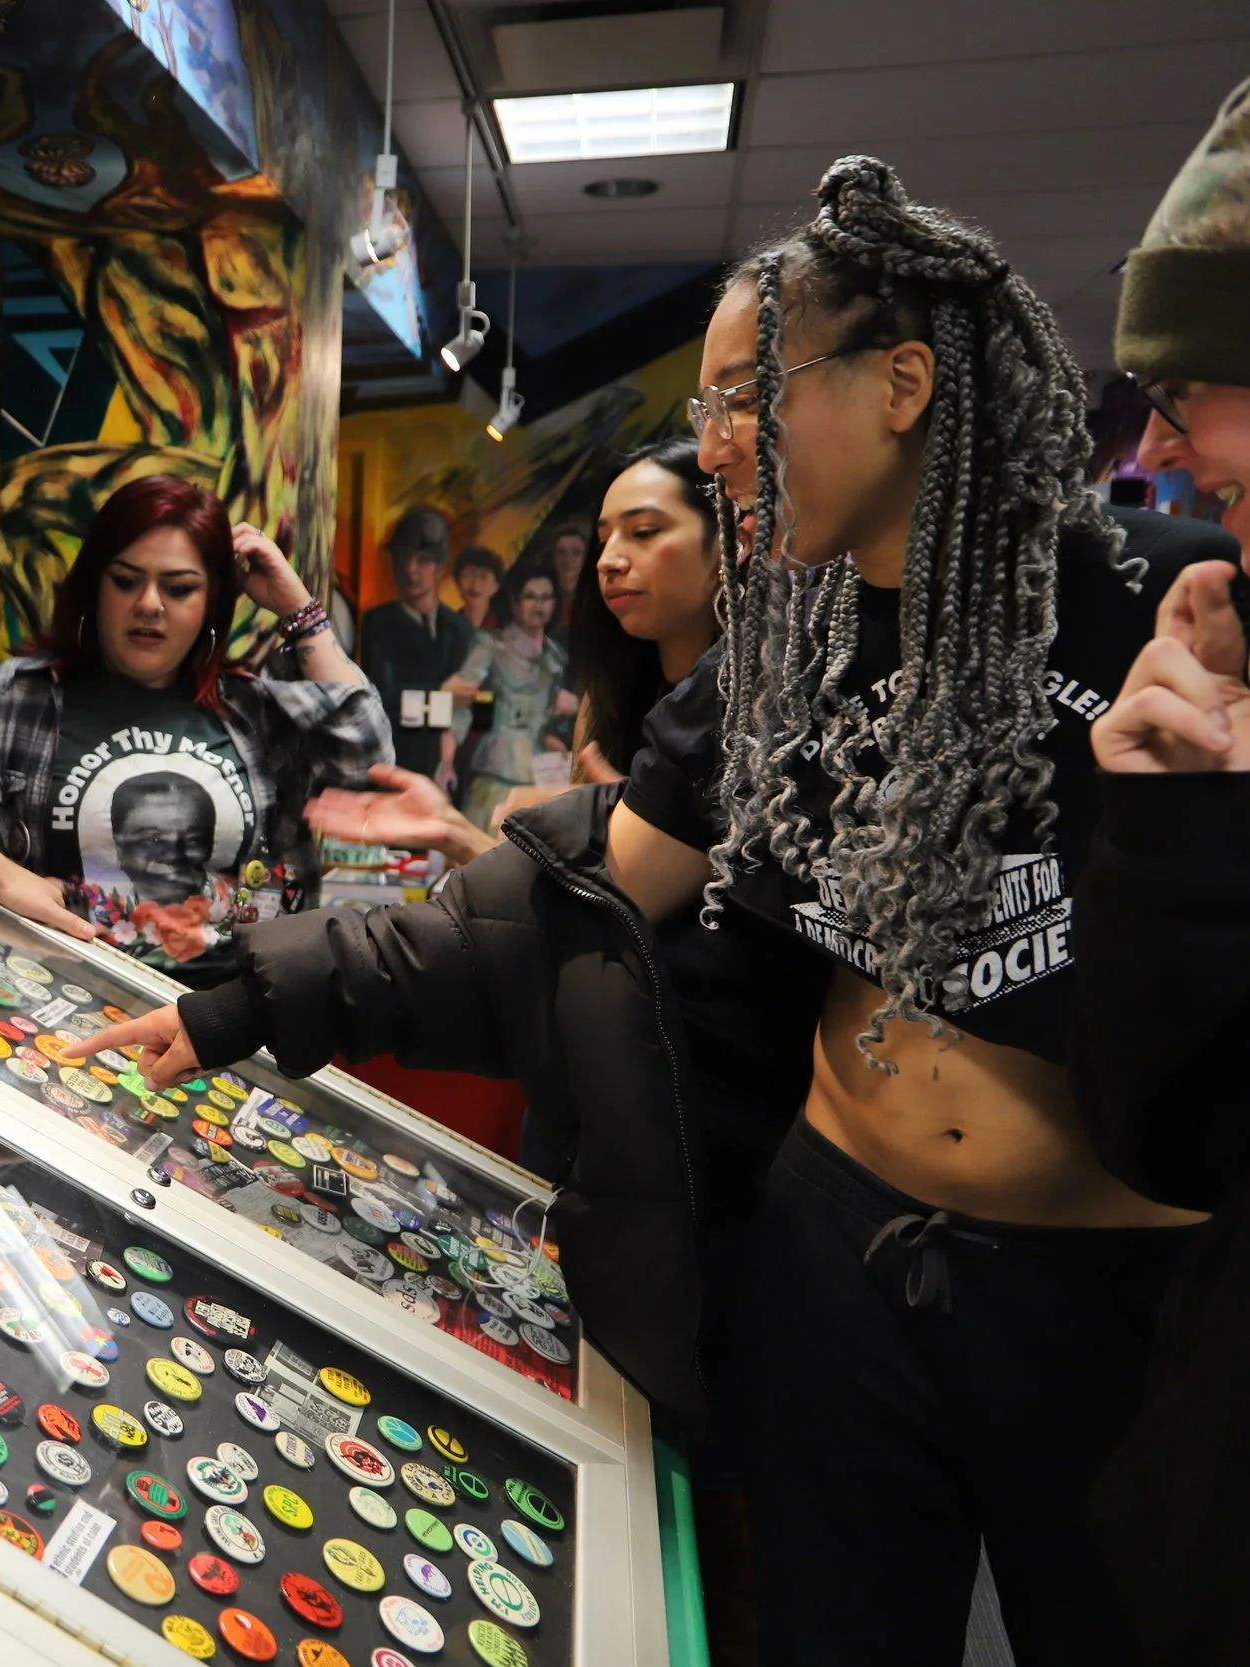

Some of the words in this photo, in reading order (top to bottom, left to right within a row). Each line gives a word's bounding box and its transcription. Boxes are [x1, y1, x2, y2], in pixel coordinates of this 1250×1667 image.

[52, 741, 113, 830] Honor
[111, 726, 173, 755] Thy
[178, 736, 255, 827] Mother
[1032, 858, 1061, 906] FOR
[395, 1285, 419, 1313] sds
[125, 1428, 137, 1441] NOW
[286, 1432, 298, 1457] STUDENT
[405, 1474, 423, 1492] GIVE
[52, 1544, 71, 1567] ethnic
[66, 1521, 86, 1547] studies
[81, 1509, 93, 1524] and
[64, 1544, 88, 1576] students
[87, 1522, 102, 1540] color
[472, 1561, 494, 1596] HELPING
